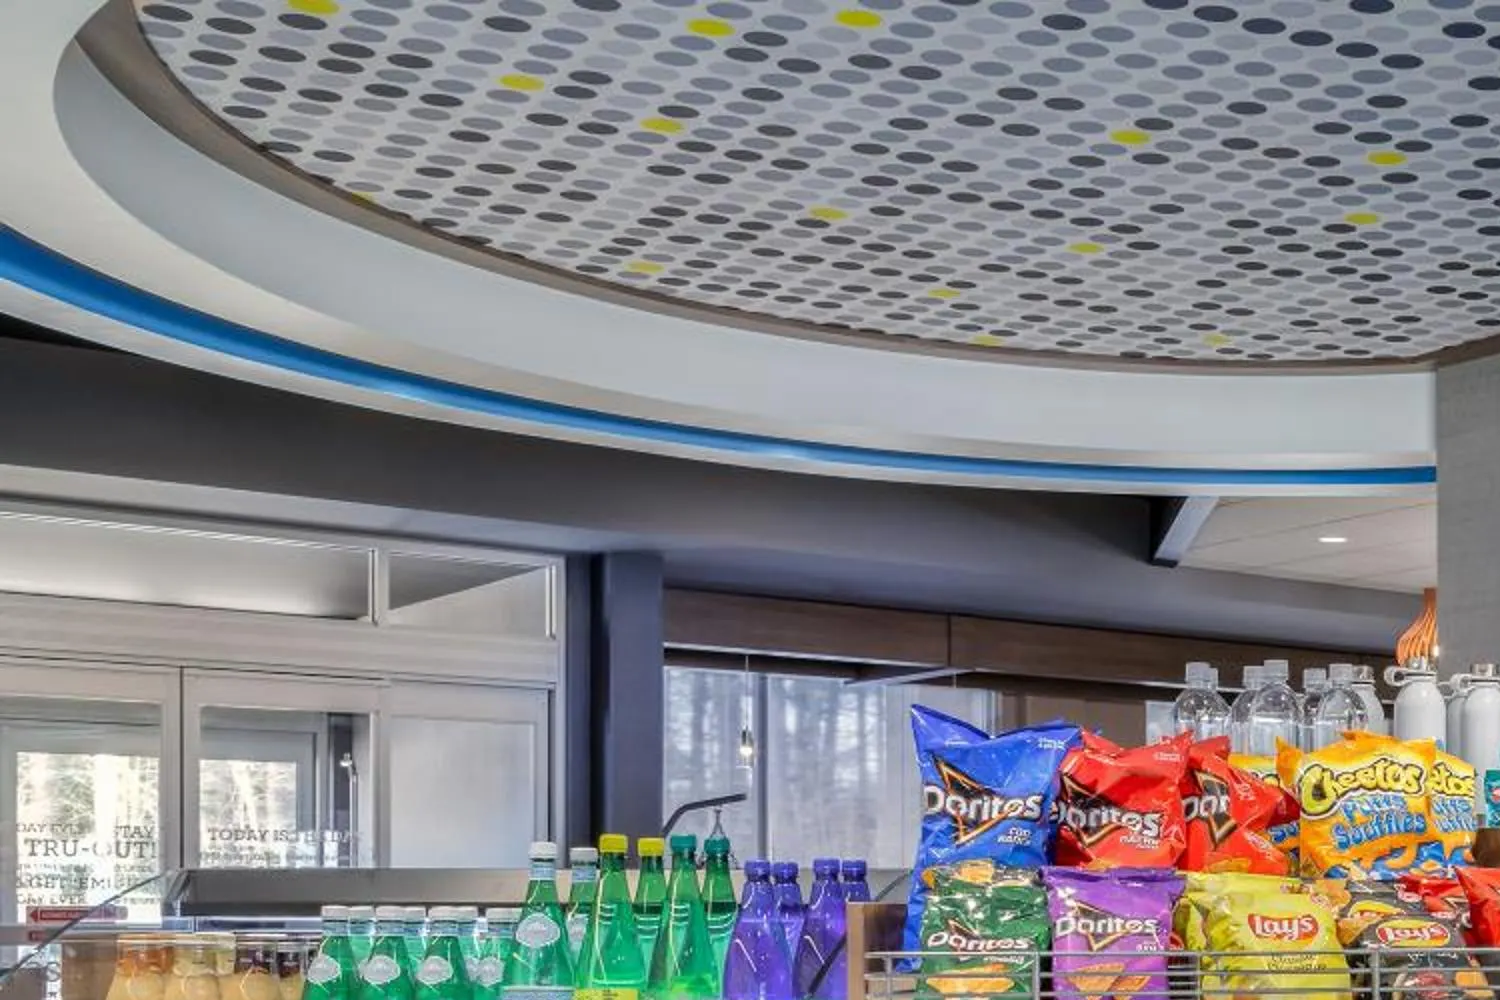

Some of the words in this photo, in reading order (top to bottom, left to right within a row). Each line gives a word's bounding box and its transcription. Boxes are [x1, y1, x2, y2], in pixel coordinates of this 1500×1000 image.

[1300, 758, 1424, 816] Cheetos
[923, 785, 1043, 822] Doritos
[1055, 917, 1162, 937] Doritos
[1254, 914, 1314, 940] Lay's
[927, 931, 1034, 951] Doritos
